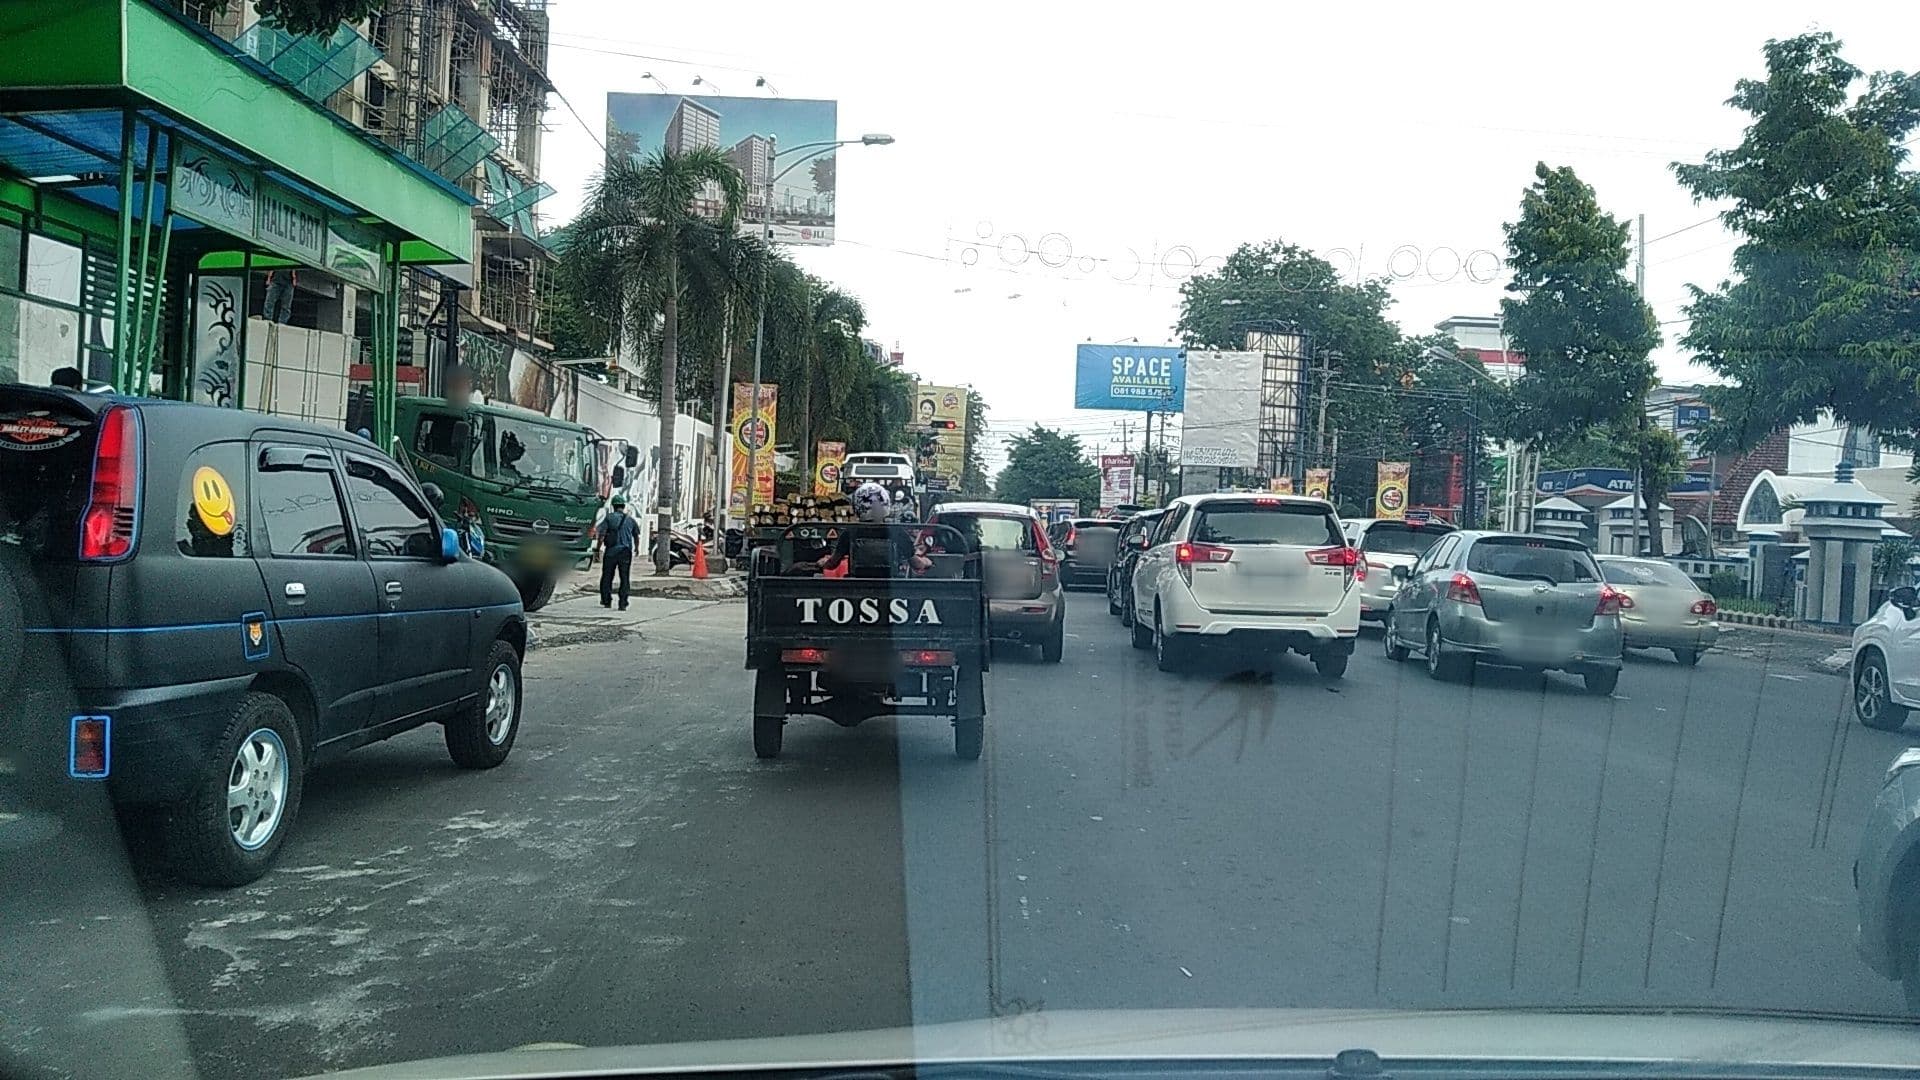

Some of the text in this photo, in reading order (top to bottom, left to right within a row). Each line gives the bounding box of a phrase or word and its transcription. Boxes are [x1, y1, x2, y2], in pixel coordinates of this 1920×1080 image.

[261, 193, 320, 251] HALTE BRT
[1112, 356, 1172, 377] SPACE
[1111, 375, 1171, 386] AVAILABLE
[1113, 387, 1129, 396] 081
[486, 507, 514, 516] HINO
[800, 529, 820, 539] 01
[796, 598, 942, 625] TOSSA
